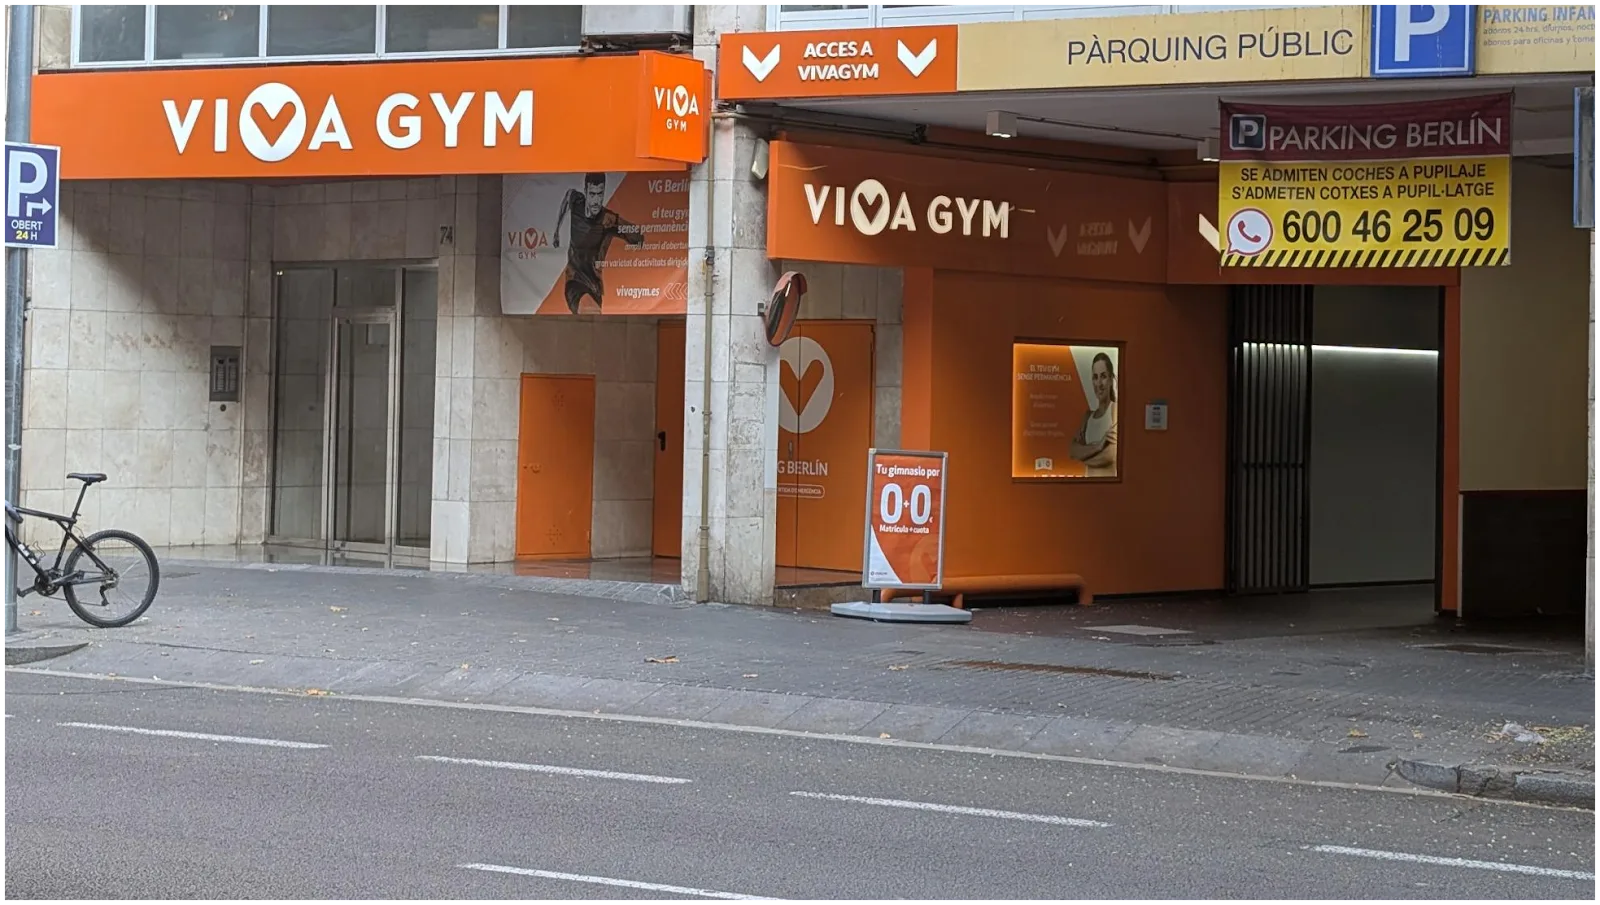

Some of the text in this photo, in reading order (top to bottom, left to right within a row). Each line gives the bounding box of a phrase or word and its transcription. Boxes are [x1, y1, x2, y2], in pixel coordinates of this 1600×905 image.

[1484, 8, 1548, 24] PARKING
[1067, 26, 1353, 65] PÀRQUING PÚBLIC
[1513, 38, 1531, 46] para
[1533, 35, 1564, 44] oficinas
[1566, 37, 1572, 45] y
[803, 41, 874, 58] ACCES A
[797, 63, 879, 80] VIVAGYM
[654, 85, 699, 117] VIVA
[162, 82, 534, 163] VIVA GYM
[666, 119, 687, 132] GYM
[1270, 112, 1501, 150] PARKING BERLÍN
[1241, 164, 1486, 182] SE ADMITEN COCHES A PUPILAJE
[7, 150, 48, 217] P
[648, 180, 662, 193] VG
[1232, 186, 1315, 200] S'ADMETEN
[1320, 185, 1378, 200] COTXES
[1382, 185, 1393, 198] A
[652, 207, 660, 218] el
[661, 208, 674, 218] teu
[927, 195, 1010, 238] GYM
[11, 219, 43, 231] OBERT
[618, 224, 639, 234] sense
[1283, 207, 1494, 243] 600 46 25 09
[16, 230, 38, 241] 24 H
[440, 226, 453, 244] 74
[518, 251, 537, 259] GYM
[616, 285, 660, 298] vivagym.es
[787, 459, 828, 476] BERLÍN
[876, 463, 940, 479] Tu gimnasio por
[880, 524, 909, 534] Matrícula
